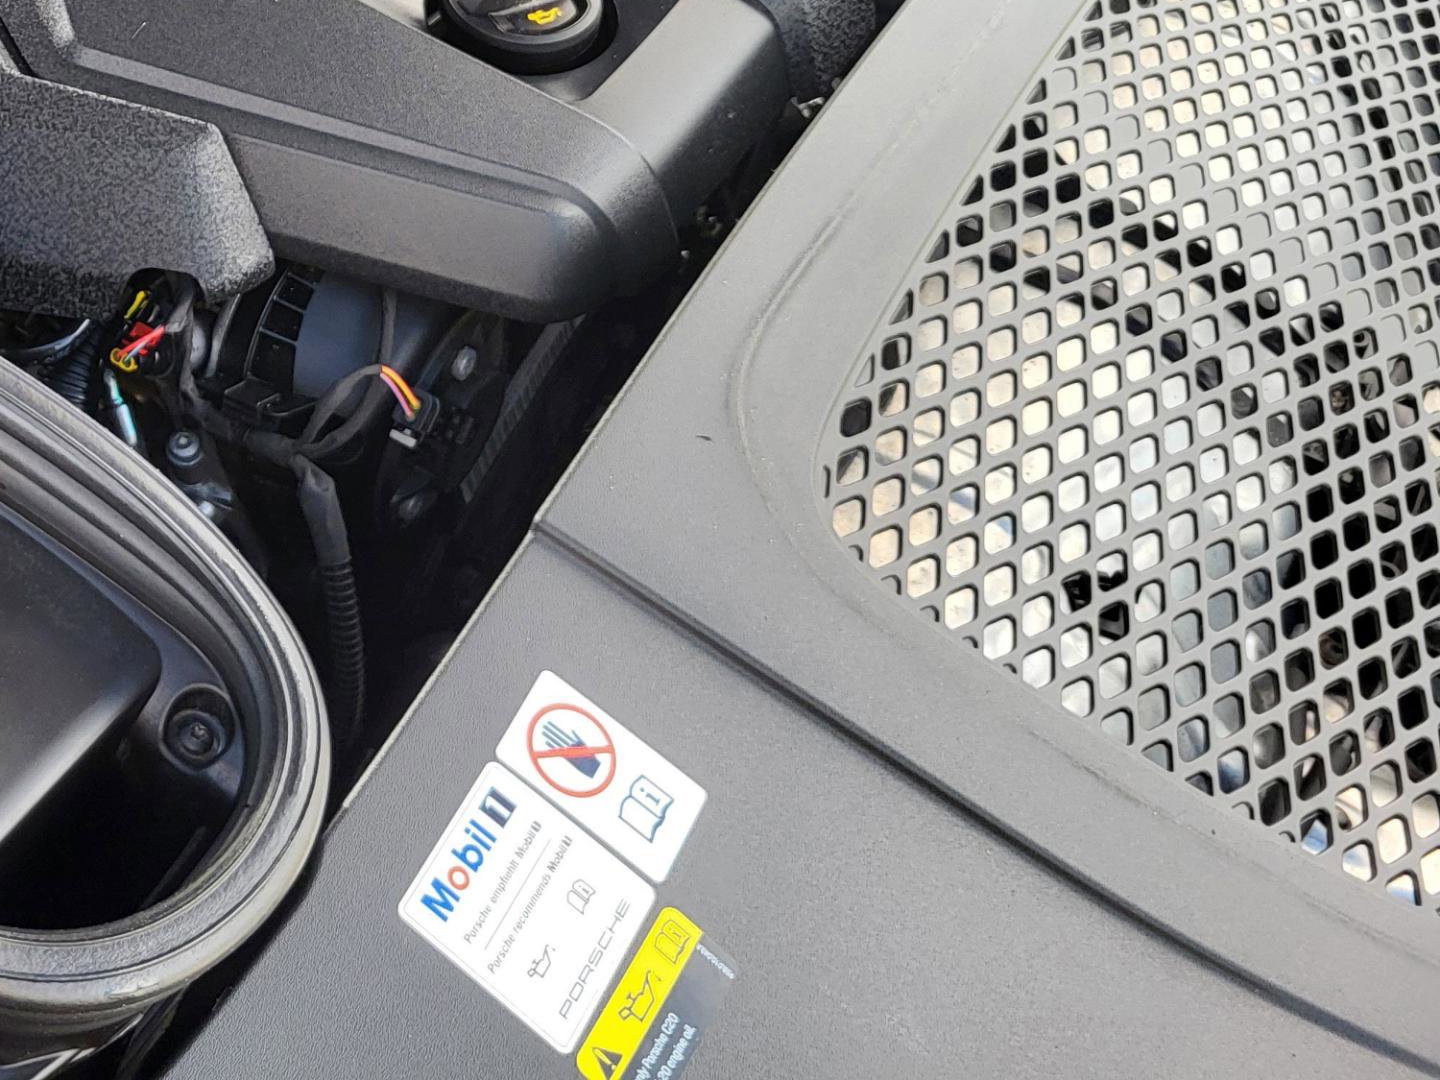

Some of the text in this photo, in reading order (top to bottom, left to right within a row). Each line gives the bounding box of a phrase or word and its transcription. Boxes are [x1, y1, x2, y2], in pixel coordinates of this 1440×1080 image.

[421, 786, 517, 923] Mobil 1
[462, 903, 493, 946] Porsche
[490, 859, 520, 904] empfiehlt
[486, 933, 516, 975] Porsche
[512, 874, 552, 934] recommends
[558, 898, 631, 1021] PORSCHE
[641, 1032, 669, 1070] Porsche
[667, 1037, 689, 1069] engine
